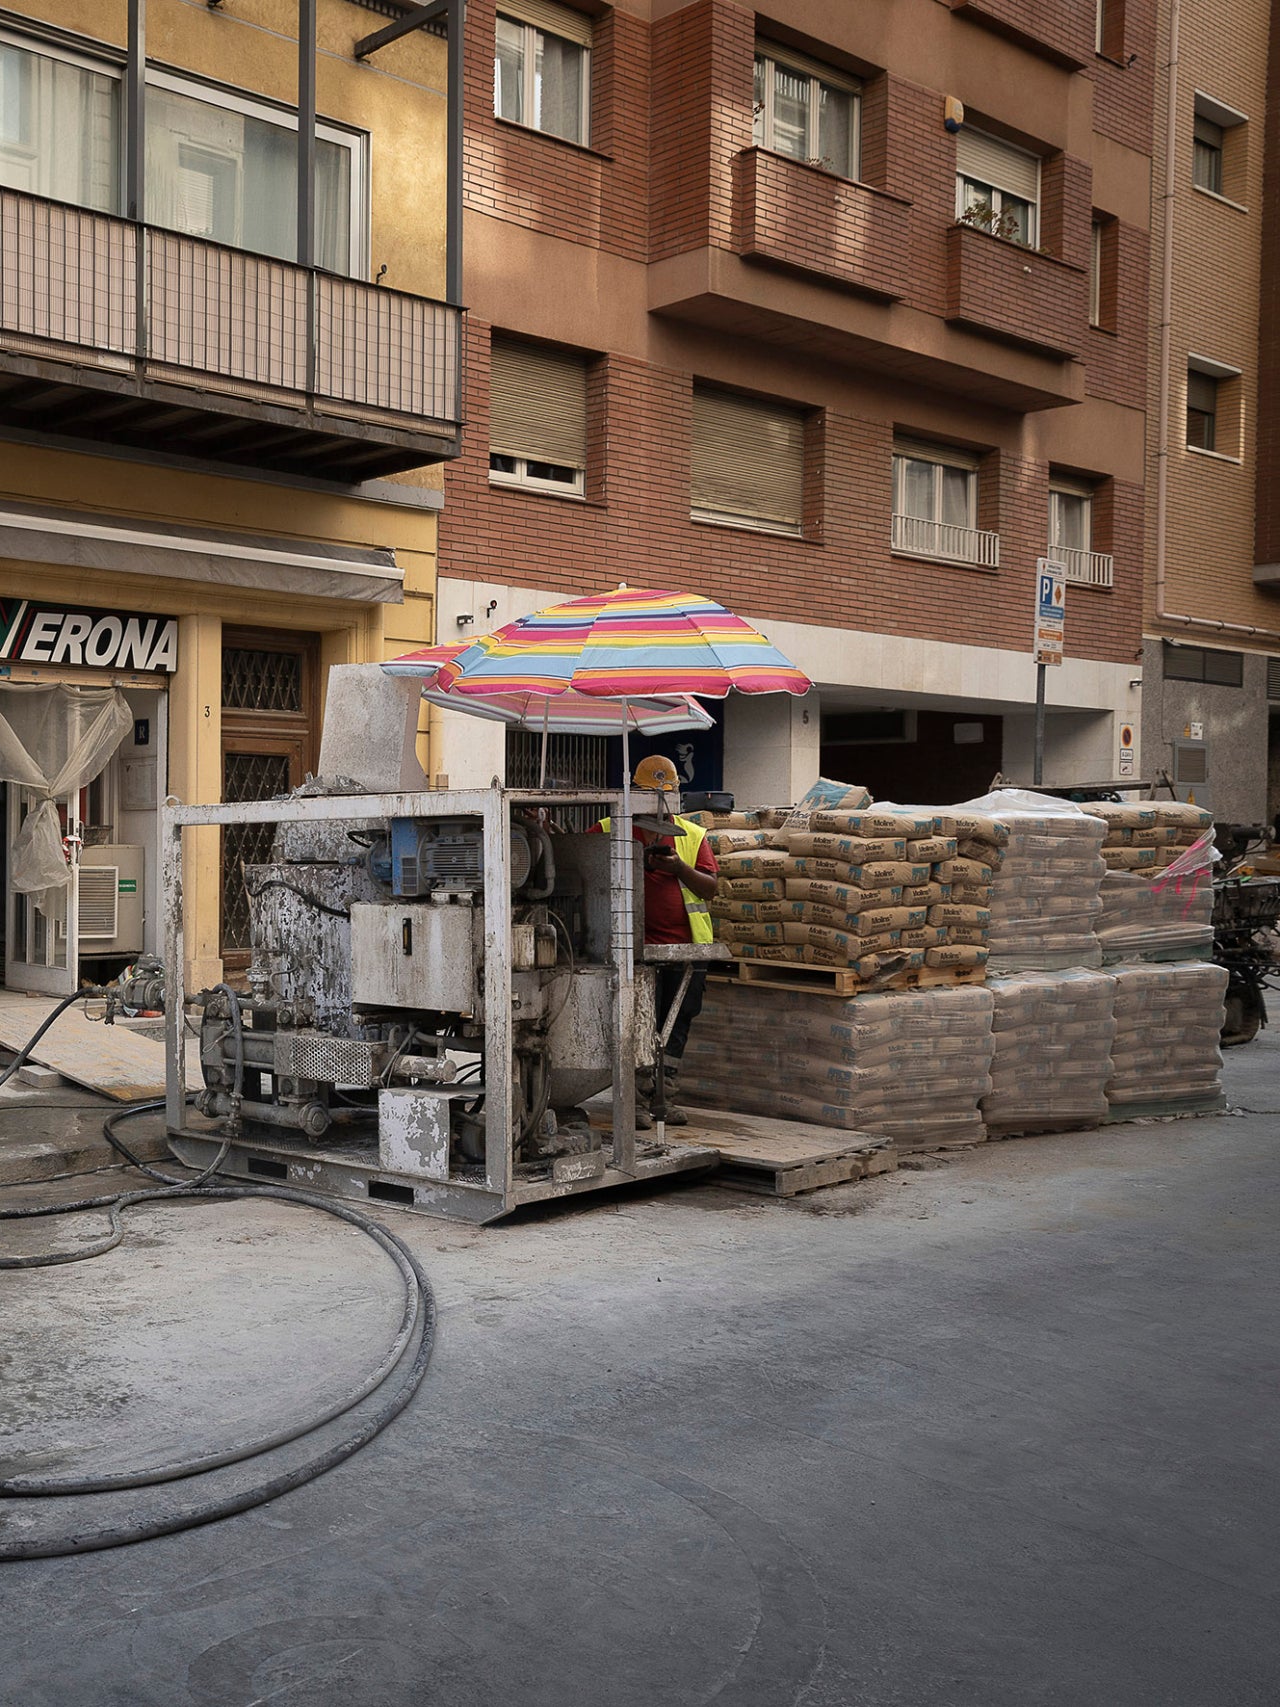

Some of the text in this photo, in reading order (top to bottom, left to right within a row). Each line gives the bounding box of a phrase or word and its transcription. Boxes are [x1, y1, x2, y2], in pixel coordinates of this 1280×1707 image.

[1042, 578, 1050, 602] P
[204, 706, 210, 718] 3
[802, 710, 809, 724] 5
